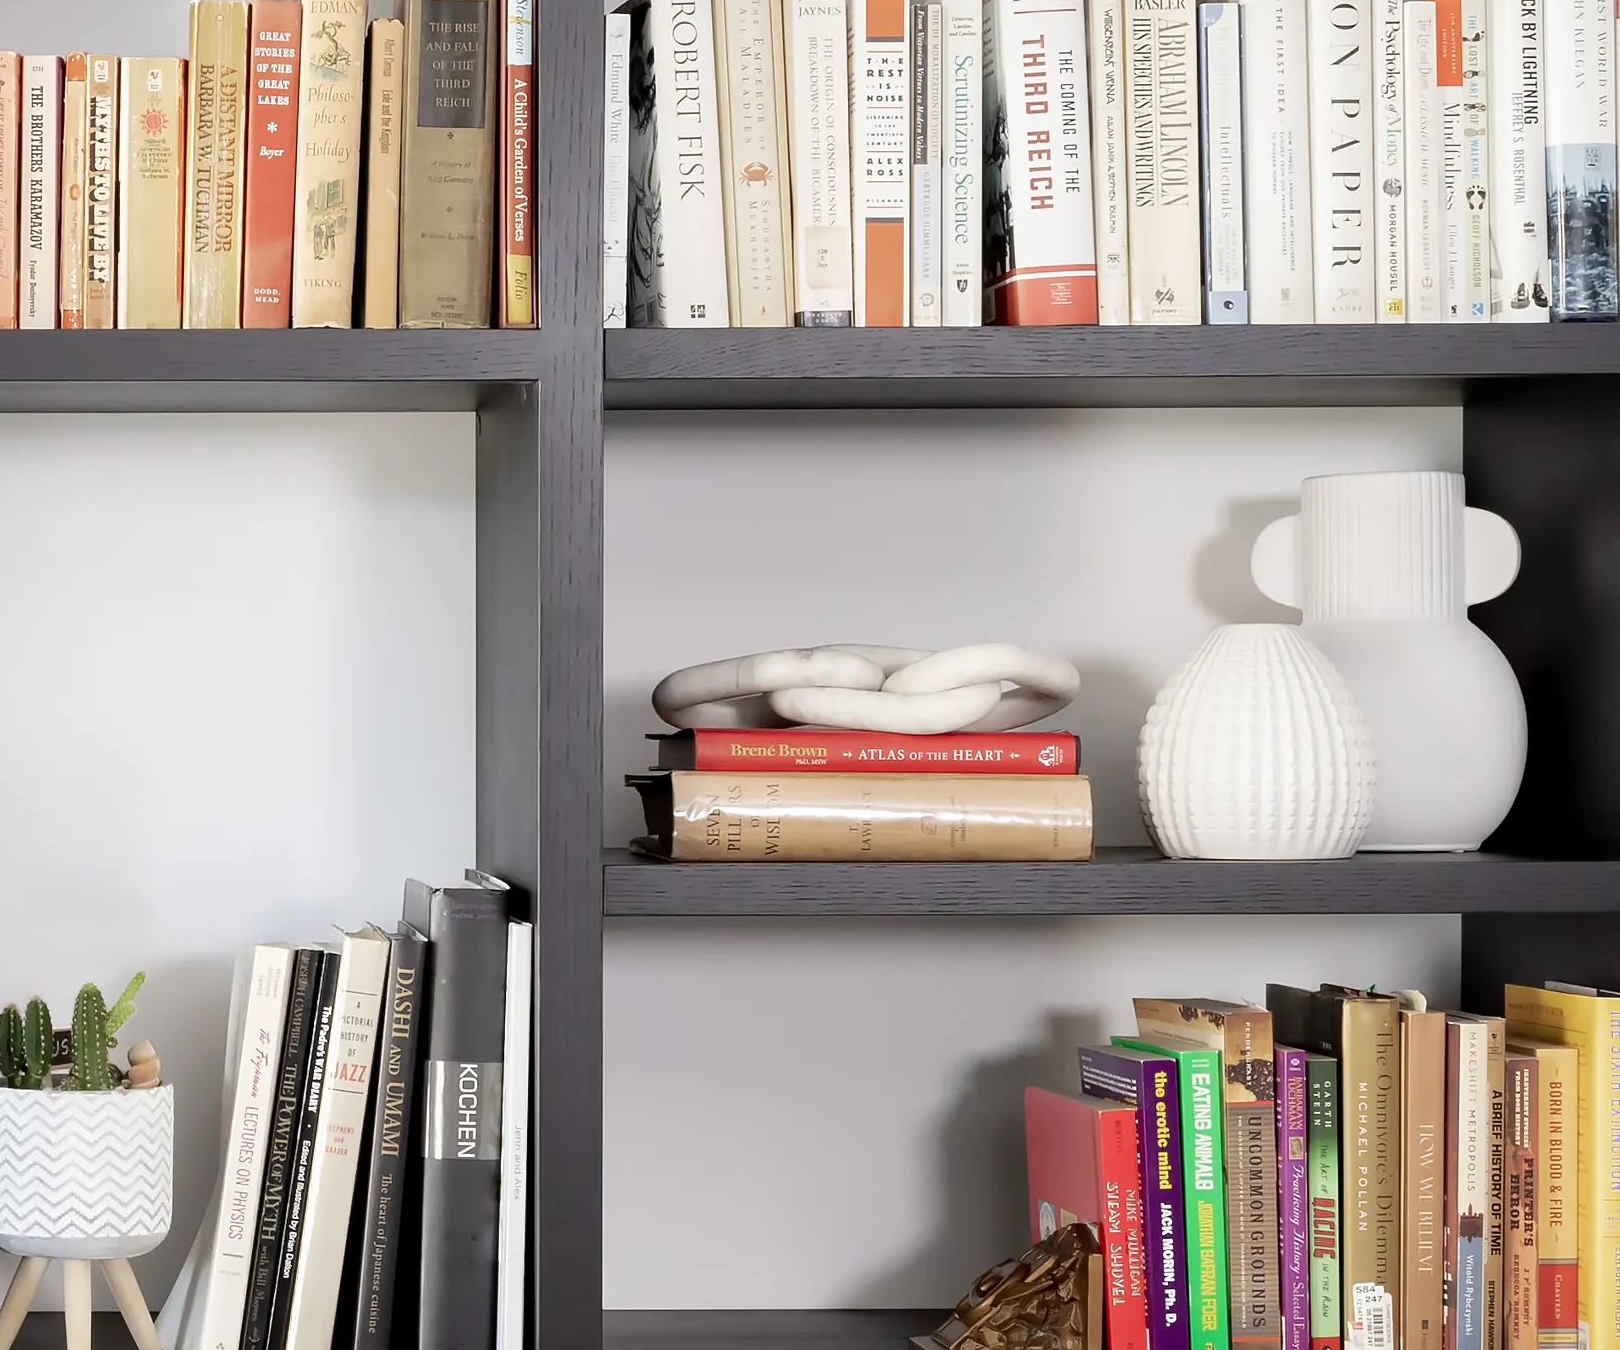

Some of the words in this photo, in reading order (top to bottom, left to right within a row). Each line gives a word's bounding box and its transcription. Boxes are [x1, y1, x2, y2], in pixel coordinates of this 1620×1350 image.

[1329, 4, 1359, 66] ON
[1522, 22, 1536, 41] BY
[515, 79, 526, 89] A
[670, 1, 701, 124] ROBERT
[1022, 34, 1048, 115] THIRD
[1522, 47, 1538, 126] LIGHTNING
[30, 86, 43, 108] THE
[514, 92, 527, 135] Child's
[950, 55, 973, 168] Scrutinizing
[30, 115, 43, 173] BROTHERS
[514, 138, 527, 184] Garden
[676, 136, 705, 201] FISK
[1027, 131, 1053, 211] REICH
[516, 187, 527, 201] of
[955, 173, 973, 244] Science
[1331, 98, 1362, 270] PAPER
[30, 179, 42, 250] KARAMAZOV
[514, 202, 527, 241] Verses
[731, 744, 776, 757] Brené
[779, 745, 828, 757] Brown
[859, 749, 905, 761] ATLAS
[910, 752, 923, 761] OF
[926, 752, 948, 761] THE
[953, 750, 1003, 761] HEART
[392, 967, 415, 1038] DASHI
[388, 1044, 403, 1075] AND
[1154, 1071, 1167, 1098] the
[381, 1081, 405, 1157] UMAMI
[457, 1062, 478, 1158] KOCHEN
[1156, 1102, 1169, 1148] erotic
[1358, 1082, 1368, 1157] MICHAEL
[1550, 1082, 1561, 1114] BORN
[1550, 1121, 1562, 1133] IN
[1158, 1152, 1171, 1189] mind
[1248, 1116, 1263, 1224] UNCOMMON
[1549, 1140, 1562, 1181] BLOOD
[1358, 1167, 1368, 1231] POLLAN
[1549, 1199, 1562, 1227] FIRE
[1251, 1231, 1265, 1328] GROUNDS
